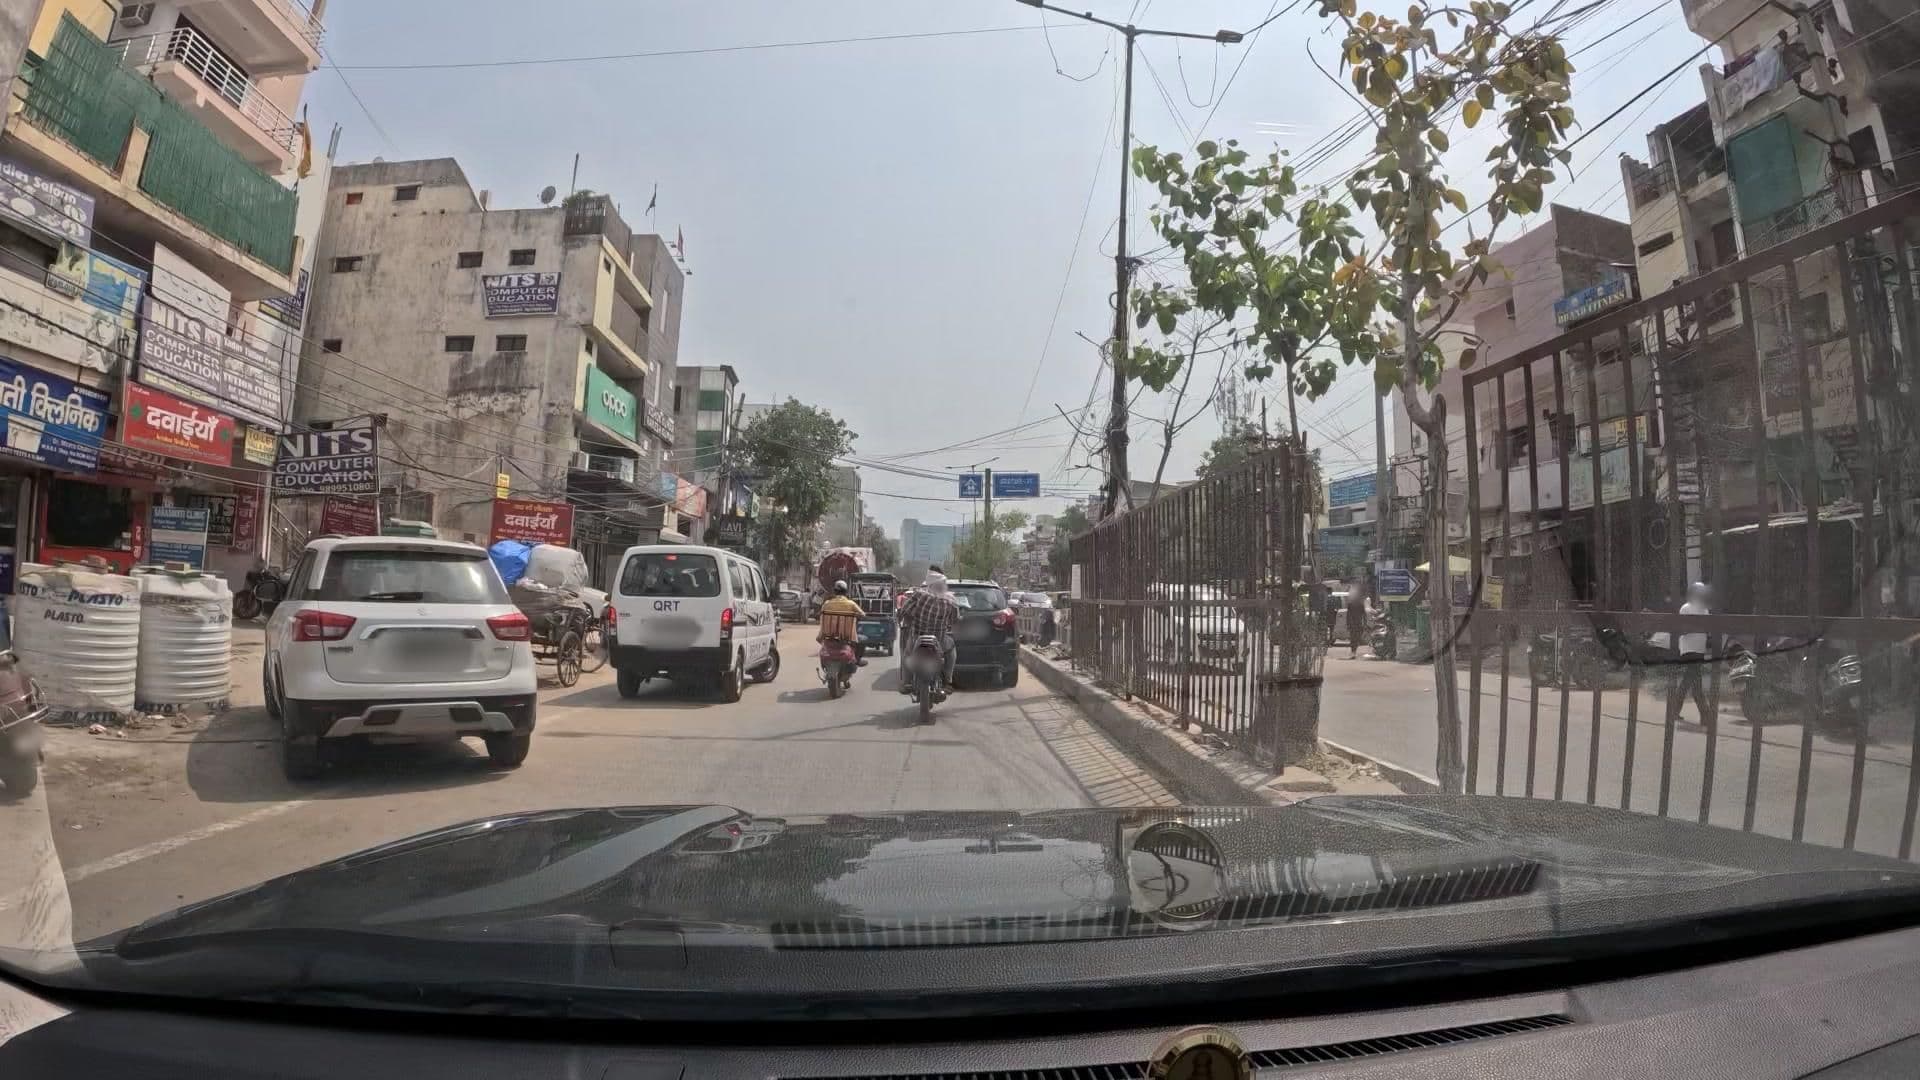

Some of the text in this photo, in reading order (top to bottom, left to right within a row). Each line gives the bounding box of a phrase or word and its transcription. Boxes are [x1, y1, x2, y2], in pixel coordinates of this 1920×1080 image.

[486, 273, 536, 288] NITS
[487, 293, 556, 303] DUCATION
[145, 329, 220, 370] COMPUTER
[144, 342, 221, 382] EDUCATION
[146, 404, 219, 442] दवाईयाँ
[279, 428, 373, 458] NITS
[275, 456, 374, 474] COMPUTER
[274, 470, 374, 487] EDUCATION
[67, 588, 123, 606] PLASTO
[653, 600, 681, 612] QRT
[44, 609, 84, 624] PLASTO
